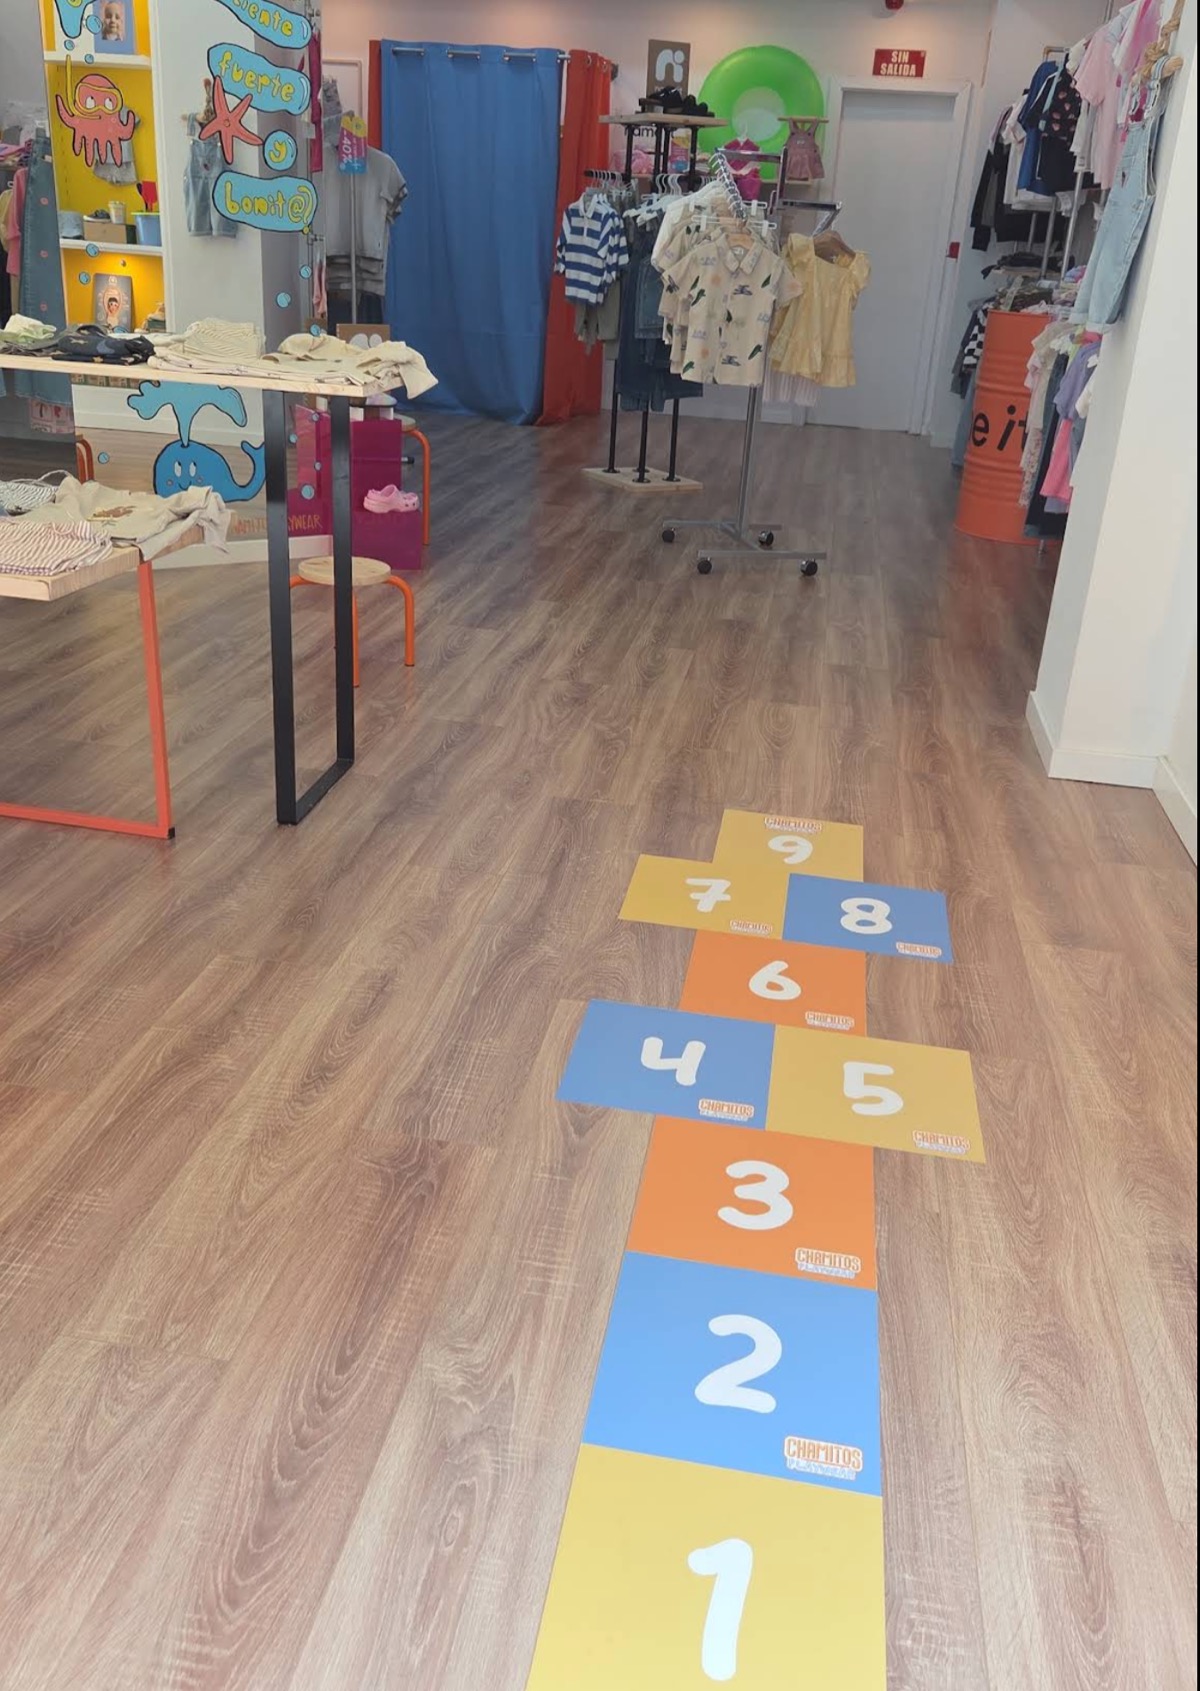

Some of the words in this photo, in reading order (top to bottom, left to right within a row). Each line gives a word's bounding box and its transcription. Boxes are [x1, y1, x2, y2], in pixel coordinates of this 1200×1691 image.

[880, 63, 916, 76] SALIDA
[891, 51, 909, 63] SIN
[218, 50, 294, 102] fuerte
[268, 140, 288, 163] y
[768, 836, 813, 864] 9
[686, 878, 731, 912] 7
[840, 897, 892, 934] 8
[749, 960, 801, 1000] 6
[641, 1036, 706, 1086] 4
[843, 1061, 904, 1116] 5
[717, 1160, 793, 1230] 3
[797, 1249, 860, 1271] CHAMITOS
[694, 1314, 782, 1413] 2
[786, 1438, 862, 1470] CHAMITOS
[687, 1537, 753, 1681] 1
